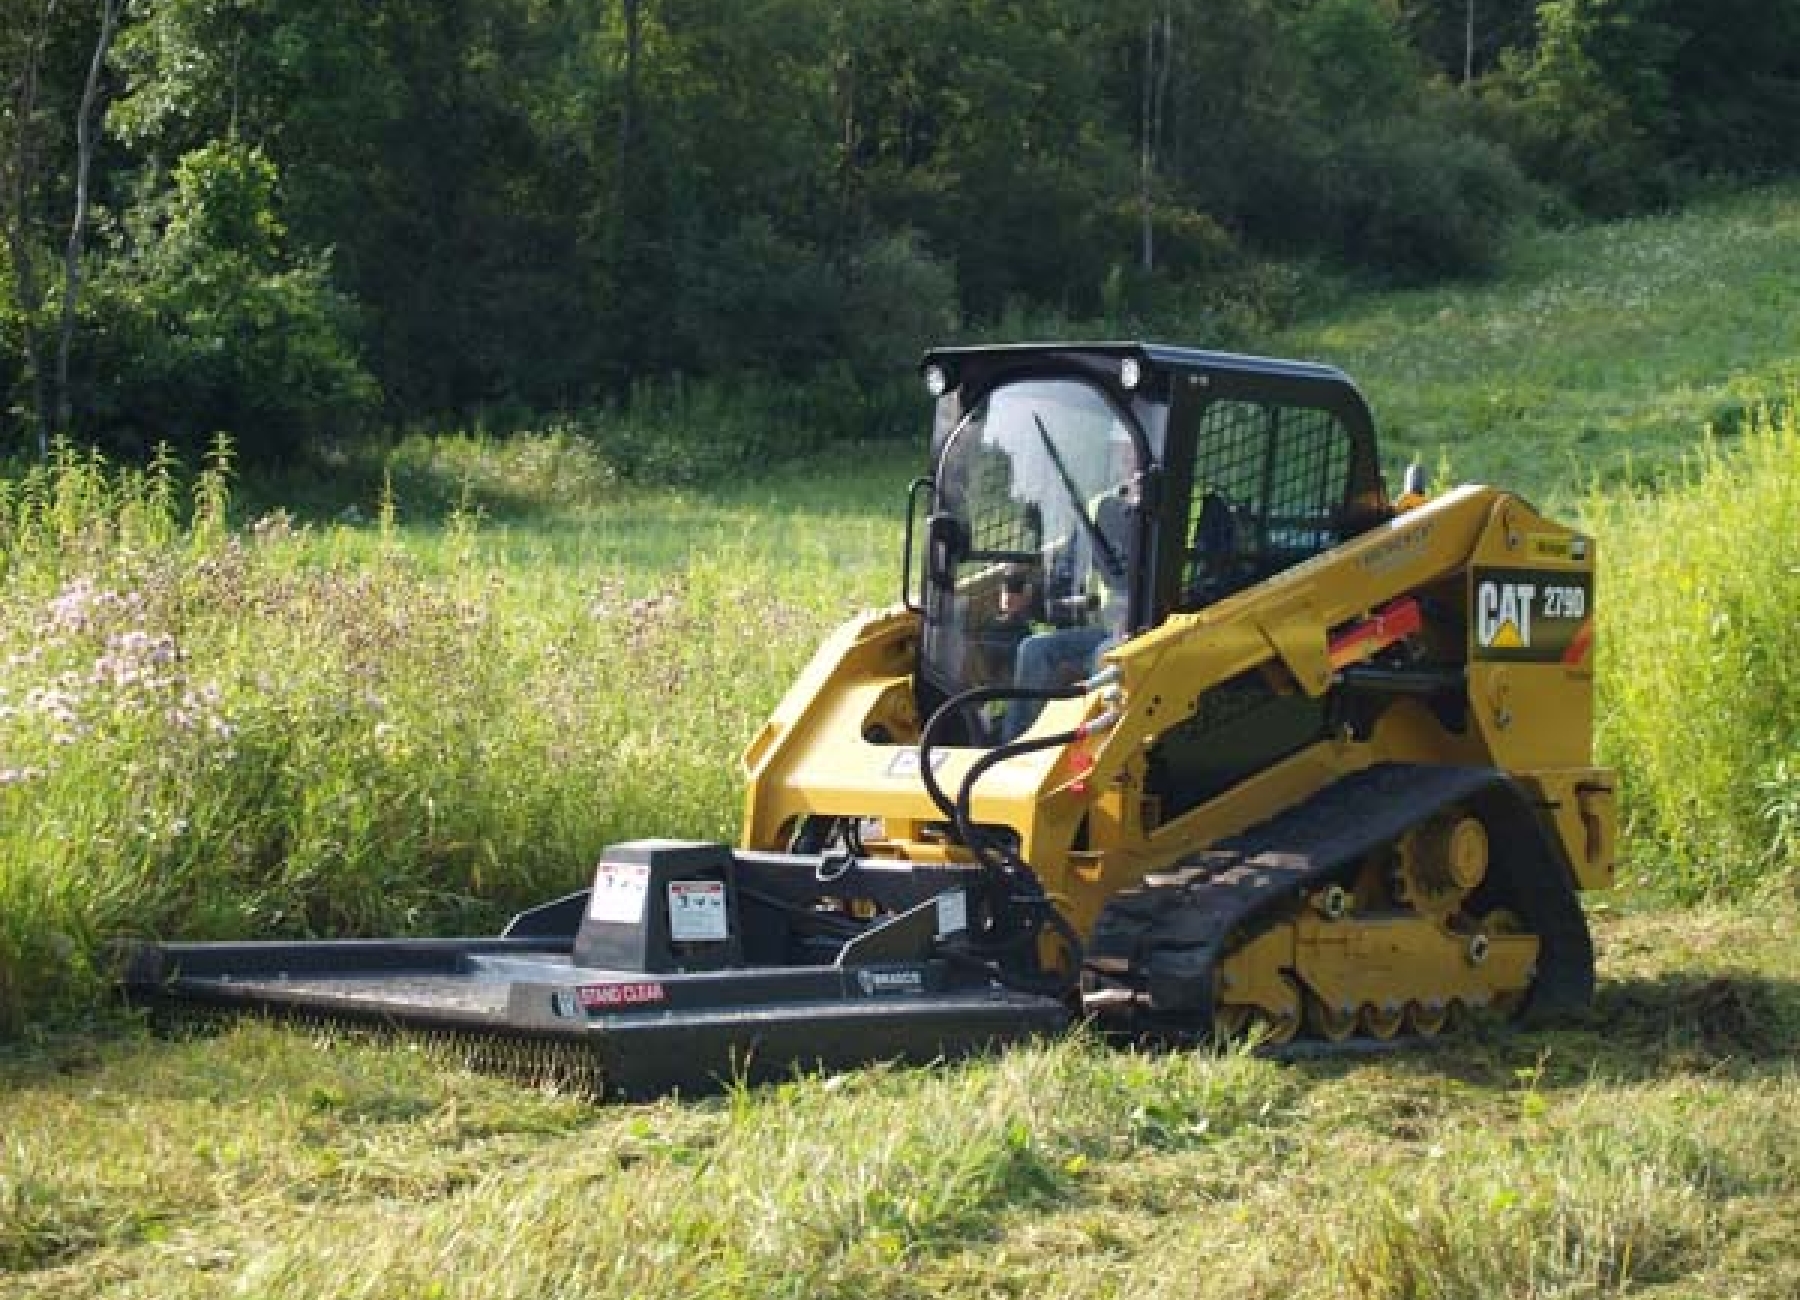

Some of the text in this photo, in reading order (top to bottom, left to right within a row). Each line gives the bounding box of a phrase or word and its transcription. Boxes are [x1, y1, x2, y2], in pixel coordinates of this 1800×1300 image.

[1478, 581, 1585, 647] CAT 279D
[623, 983, 665, 1002] CLEAR
